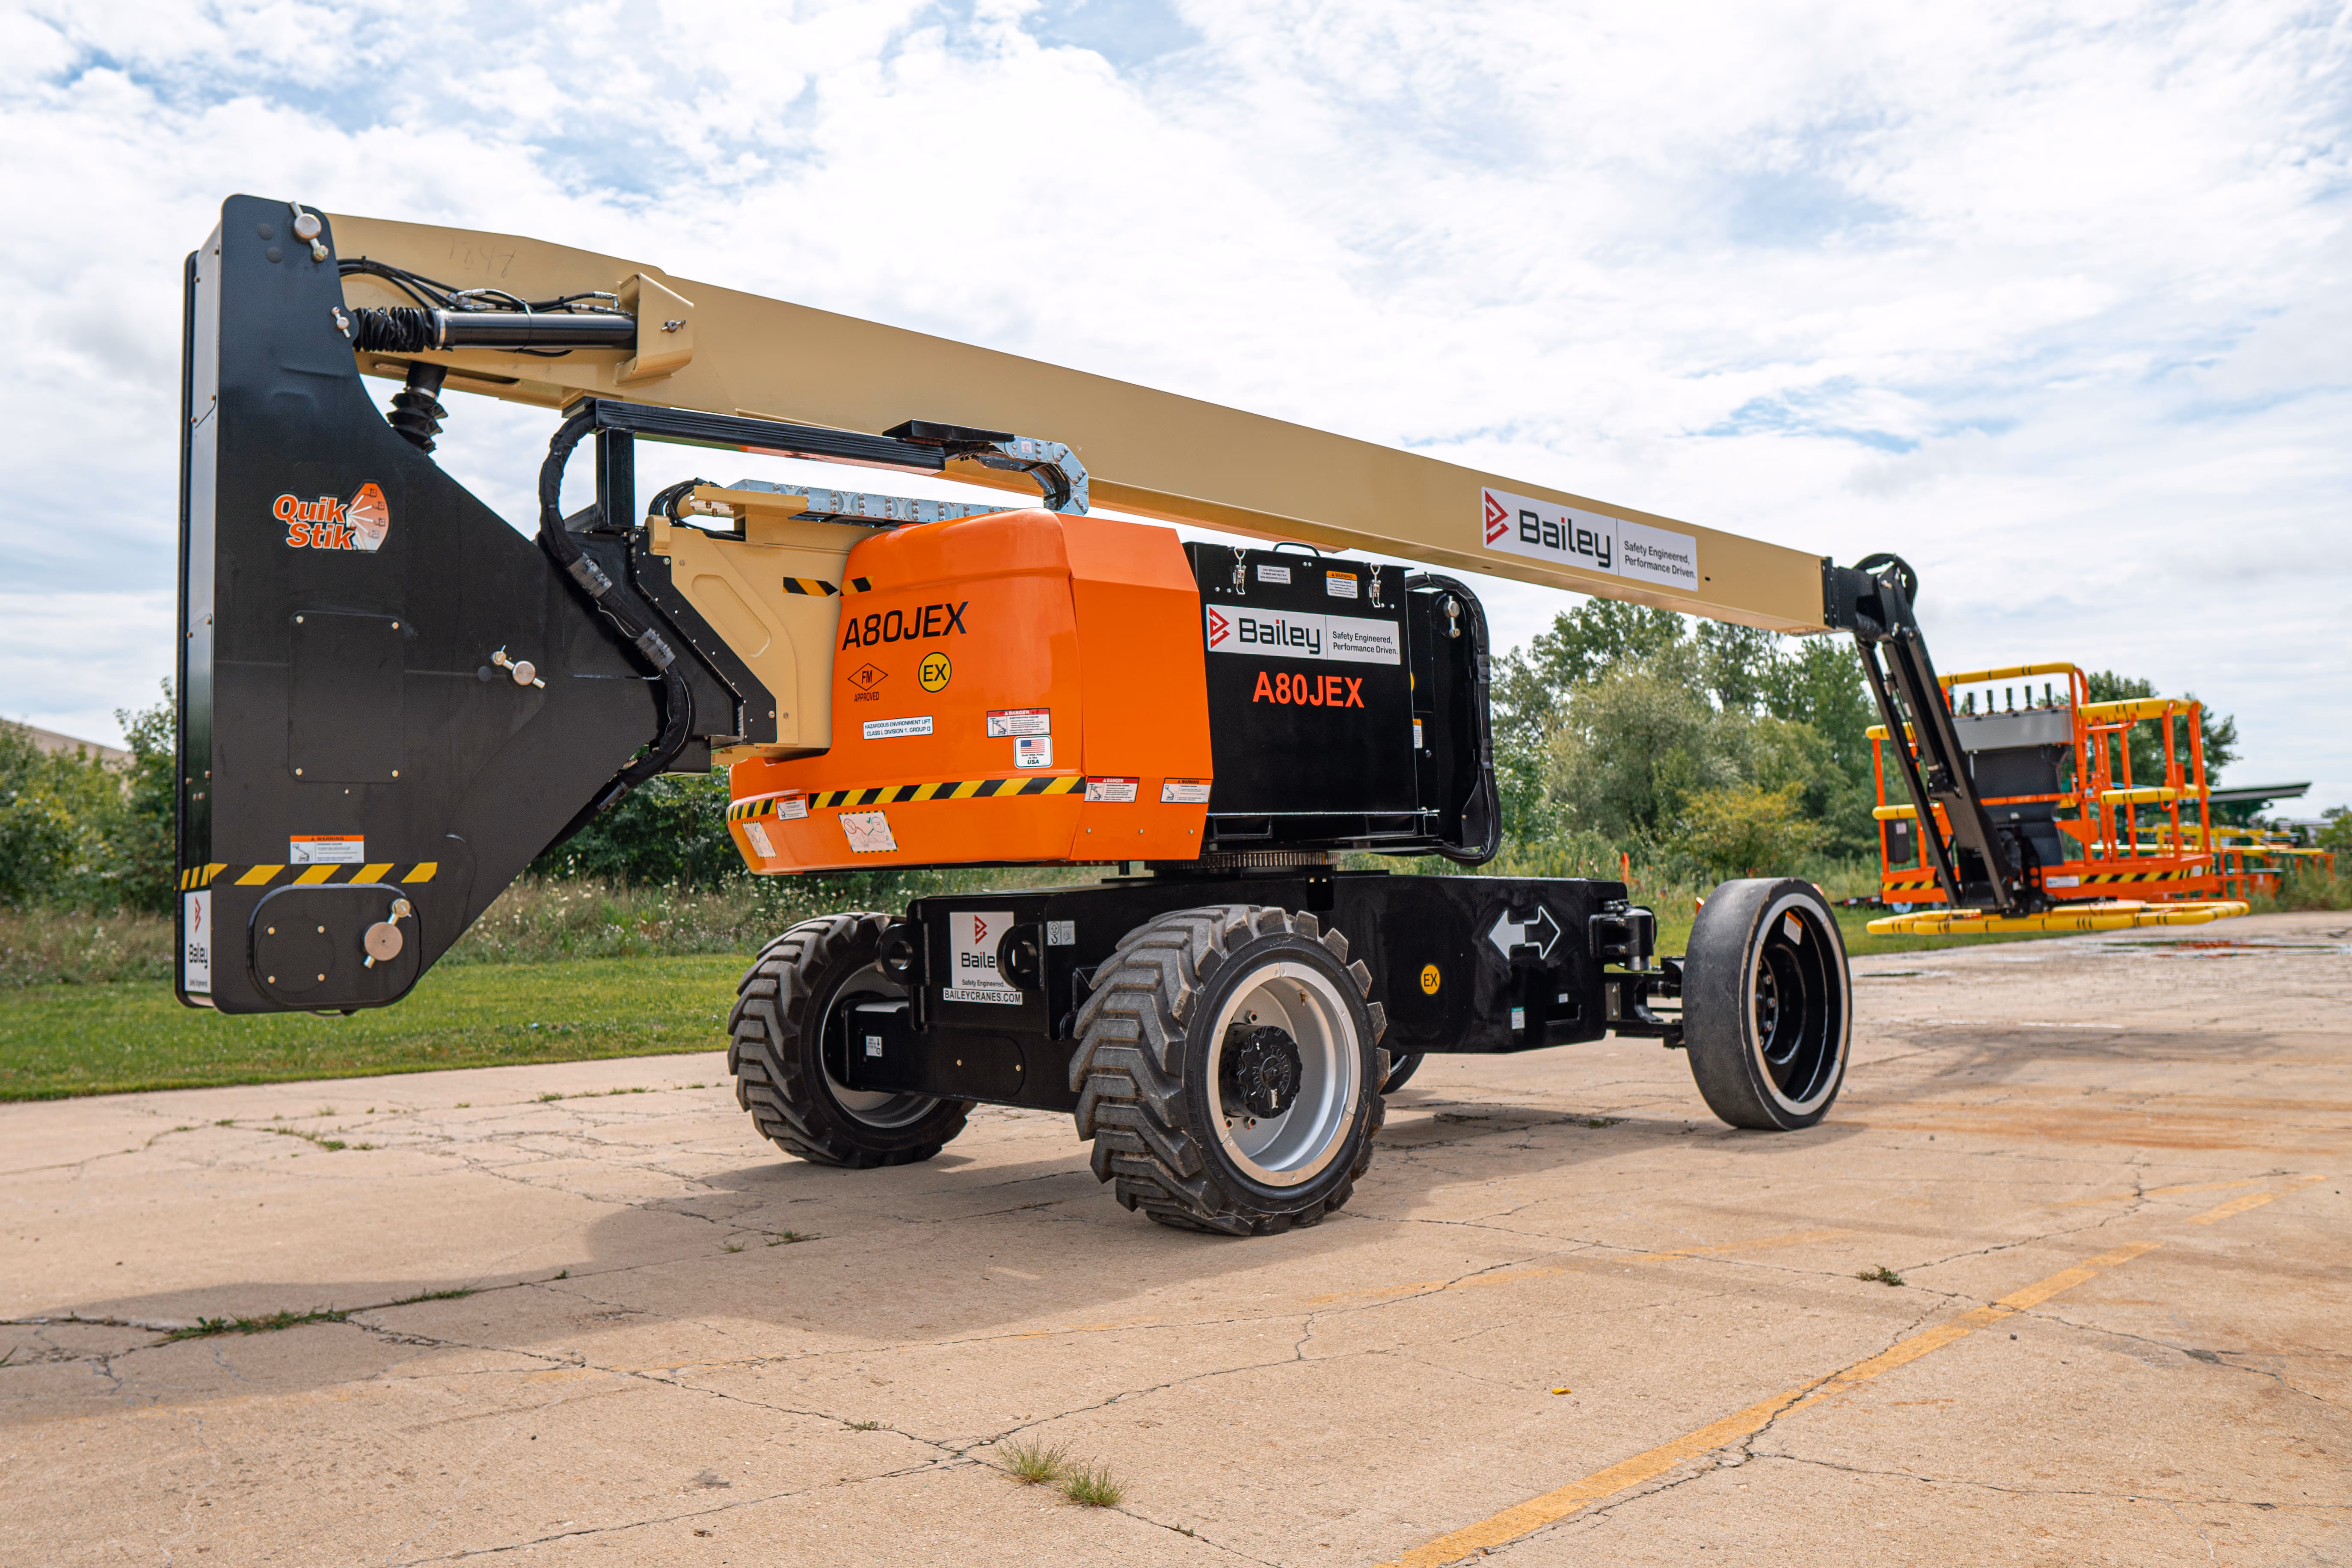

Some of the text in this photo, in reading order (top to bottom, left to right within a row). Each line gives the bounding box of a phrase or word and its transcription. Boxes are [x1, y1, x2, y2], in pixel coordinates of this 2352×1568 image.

[273, 493, 348, 524] Quik
[285, 522, 355, 550] Stik
[1519, 509, 1611, 568] Bailey
[1624, 540, 1690, 565] Safety Engineered,
[1625, 555, 1696, 579] Performance Driven.
[842, 601, 969, 651] A80JEX
[1239, 618, 1320, 655] Bailey
[1333, 631, 1392, 644] Safety Engineered,
[1333, 643, 1398, 655] Performance Driven.
[861, 670, 872, 684] FM
[923, 664, 947, 682] EX
[854, 691, 879, 702] APPROVED
[1253, 672, 1364, 708] A80JEX
[189, 942, 208, 969] Bailey
[961, 951, 996, 968] Baile
[1424, 973, 1438, 987] EX
[944, 990, 1021, 1003] BAILEYCRANES.COM
[1270, 1045, 1289, 1091] TORQUE
